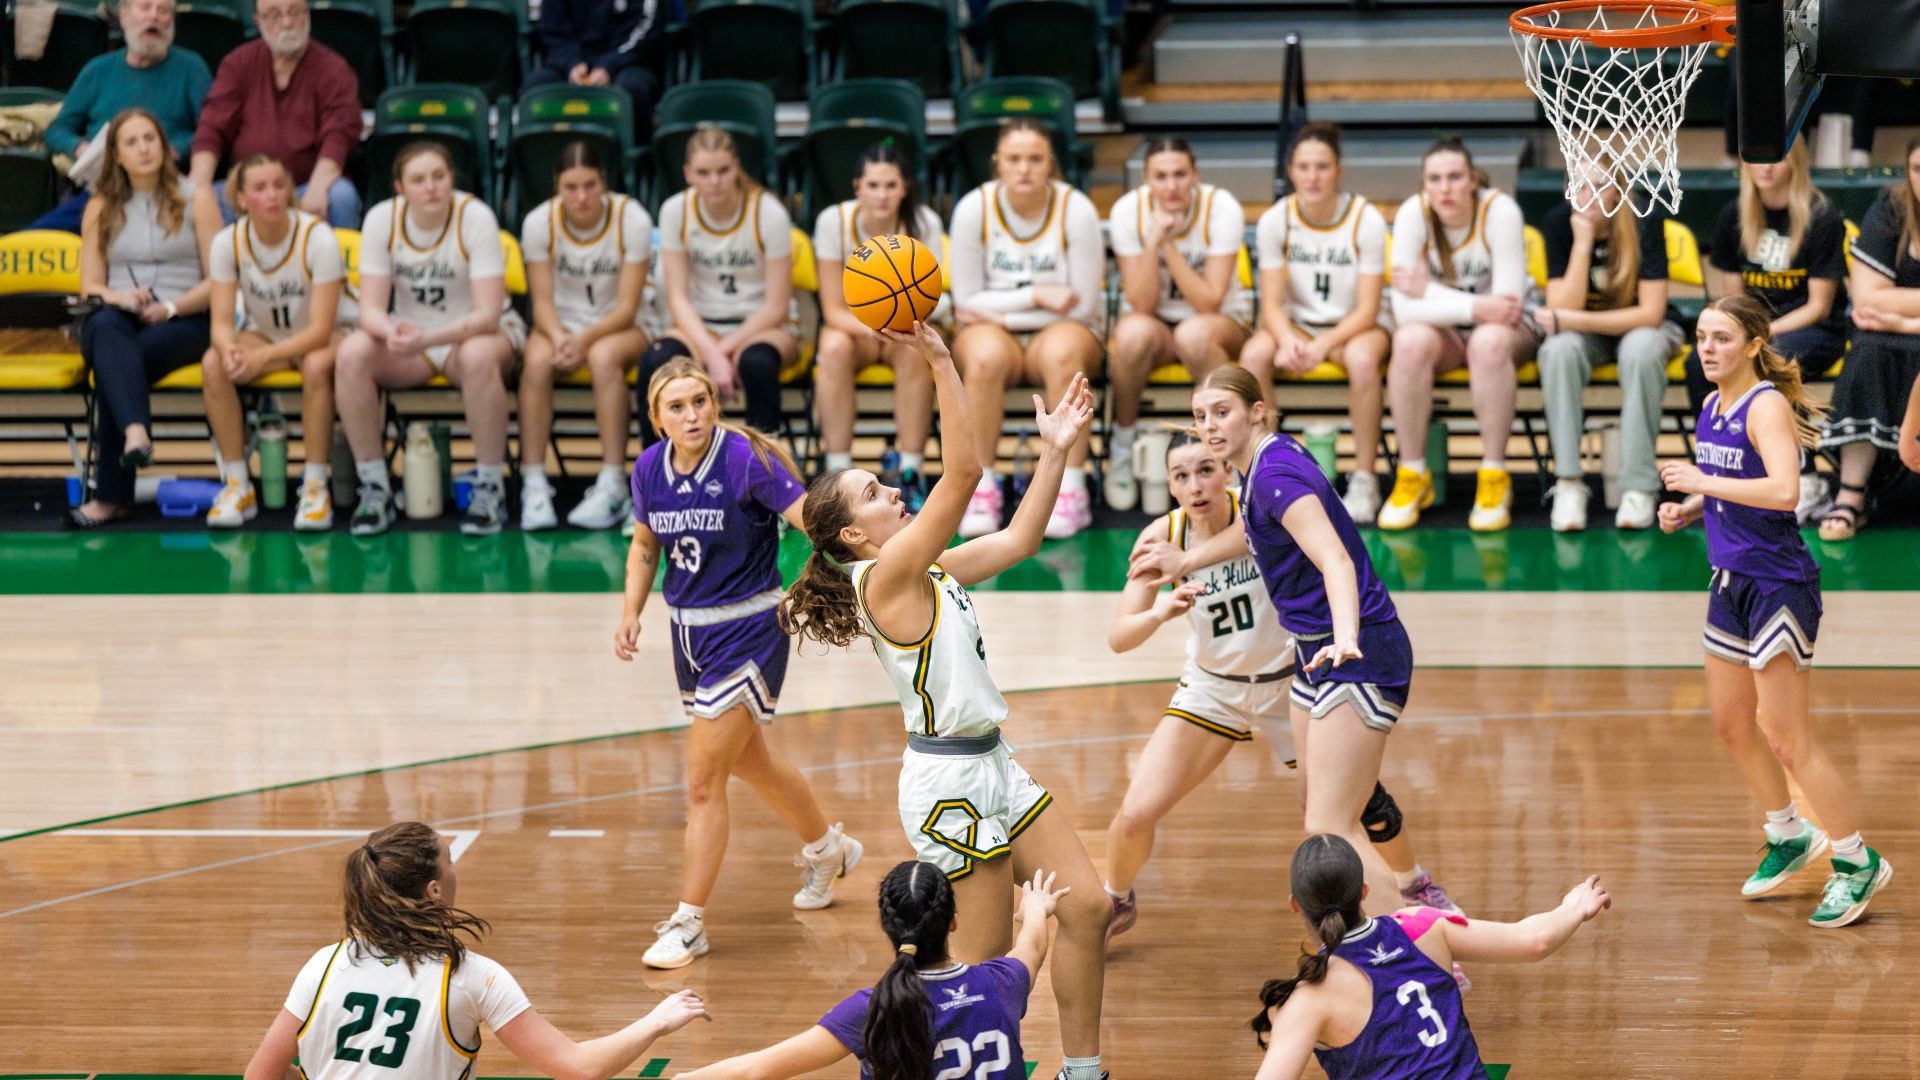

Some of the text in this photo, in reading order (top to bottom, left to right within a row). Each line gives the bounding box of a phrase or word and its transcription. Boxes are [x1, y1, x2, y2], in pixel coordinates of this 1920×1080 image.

[586, 284, 595, 306] 1
[1315, 272, 1330, 301] 4
[272, 304, 290, 328] 11
[1696, 441, 1744, 470] ESTMINSTER
[670, 536, 701, 574] 43
[1223, 559, 1260, 590] Hills
[1207, 593, 1254, 638] 20
[333, 991, 421, 1069] 23
[1396, 980, 1447, 1047] 3
[933, 1029, 1011, 1080] 22
